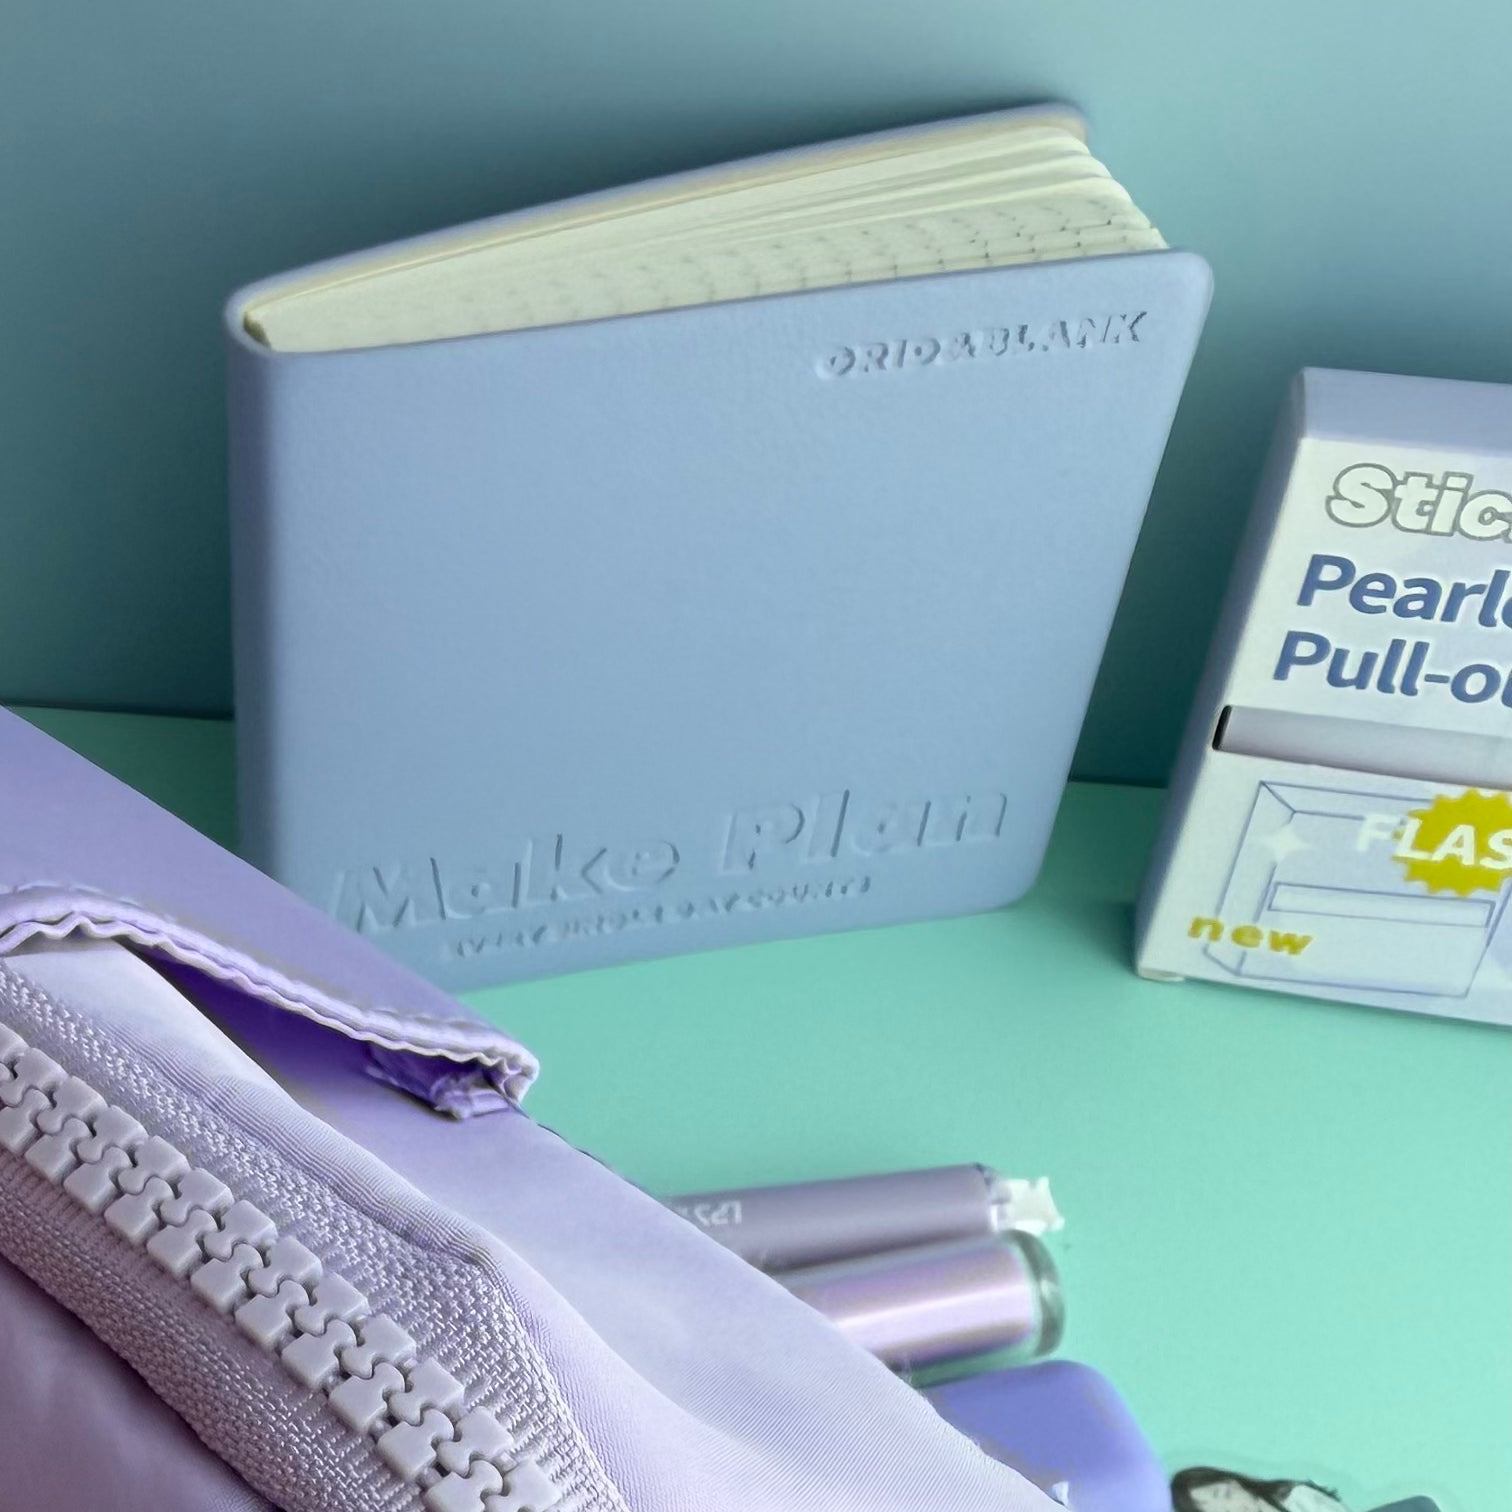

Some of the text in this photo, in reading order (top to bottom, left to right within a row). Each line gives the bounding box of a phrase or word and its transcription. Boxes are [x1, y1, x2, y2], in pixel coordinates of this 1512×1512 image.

[1325, 462, 1512, 543] Stic
[1297, 554, 1512, 630] Pearl
[1273, 630, 1512, 709] Pull-o
[331, 833, 681, 933] Make
[717, 789, 1008, 874] Plan
[1188, 914, 1314, 957] new
